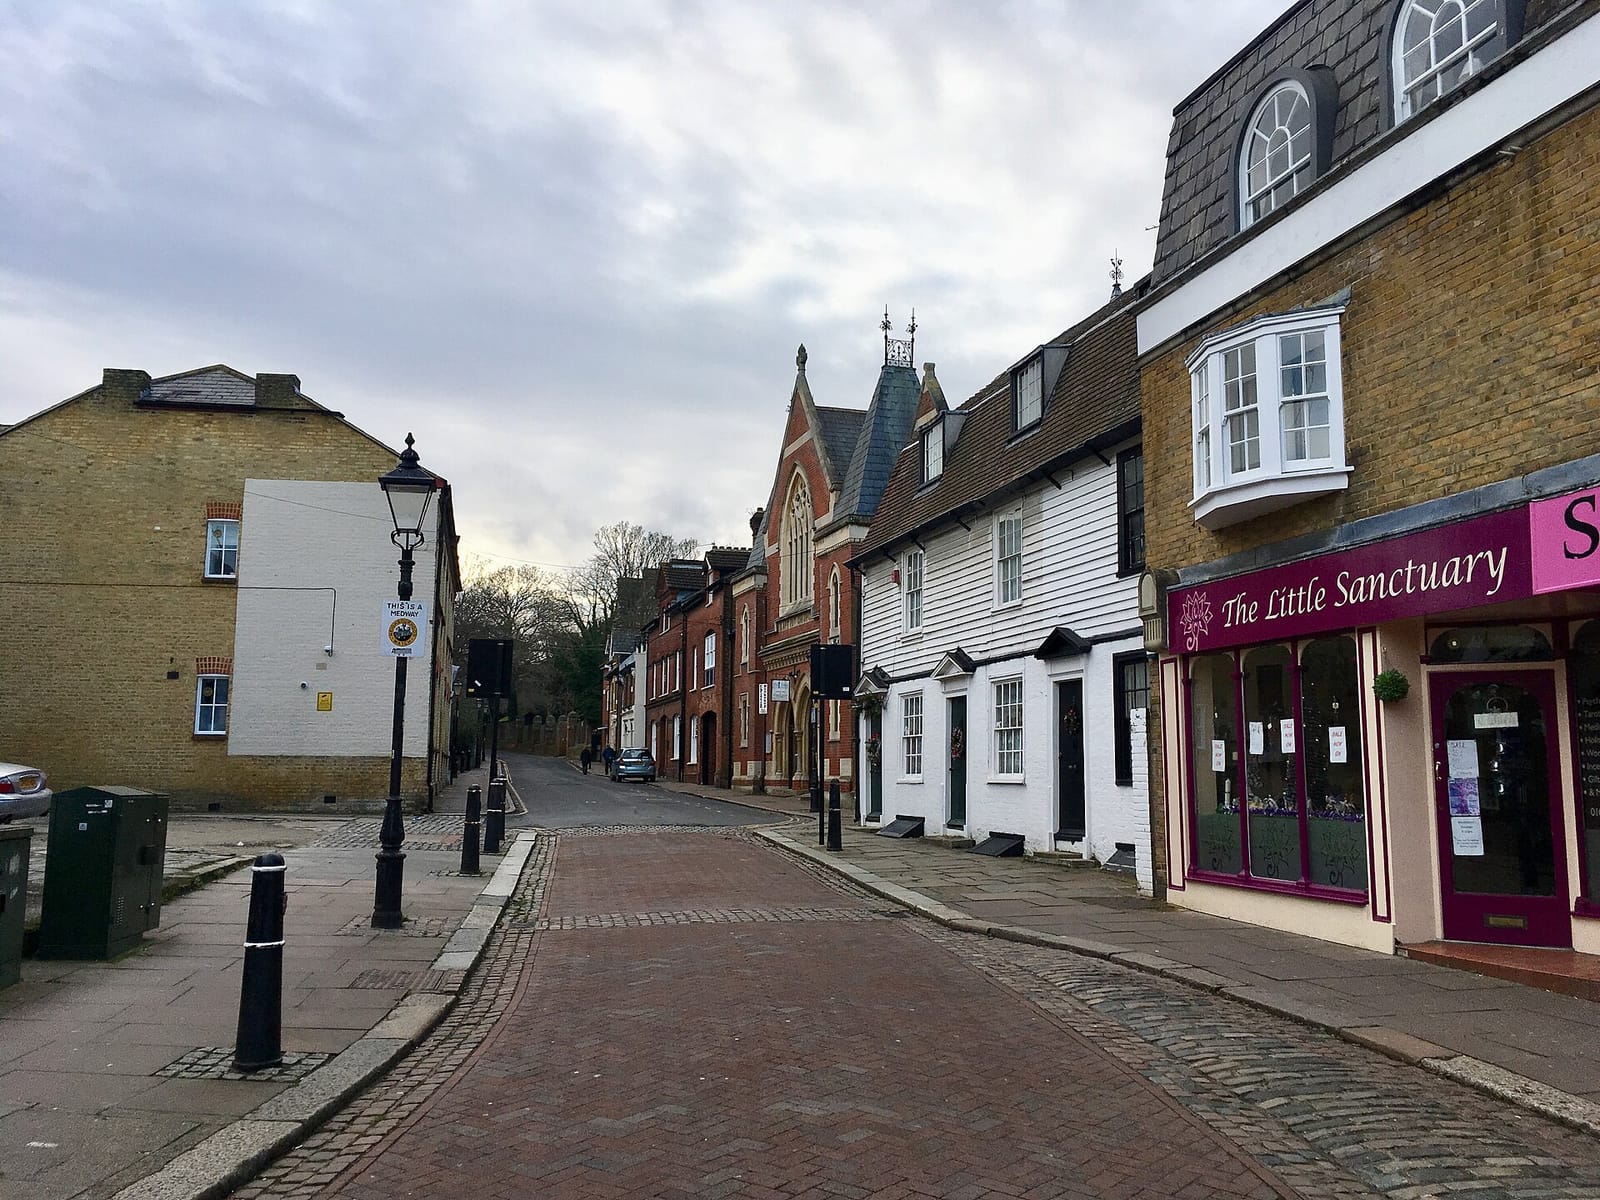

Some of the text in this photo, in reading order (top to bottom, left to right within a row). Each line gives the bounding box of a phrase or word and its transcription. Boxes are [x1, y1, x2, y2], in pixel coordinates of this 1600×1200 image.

[1563, 495, 1600, 560] S
[1221, 546, 1508, 628] The Little Sanctuary
